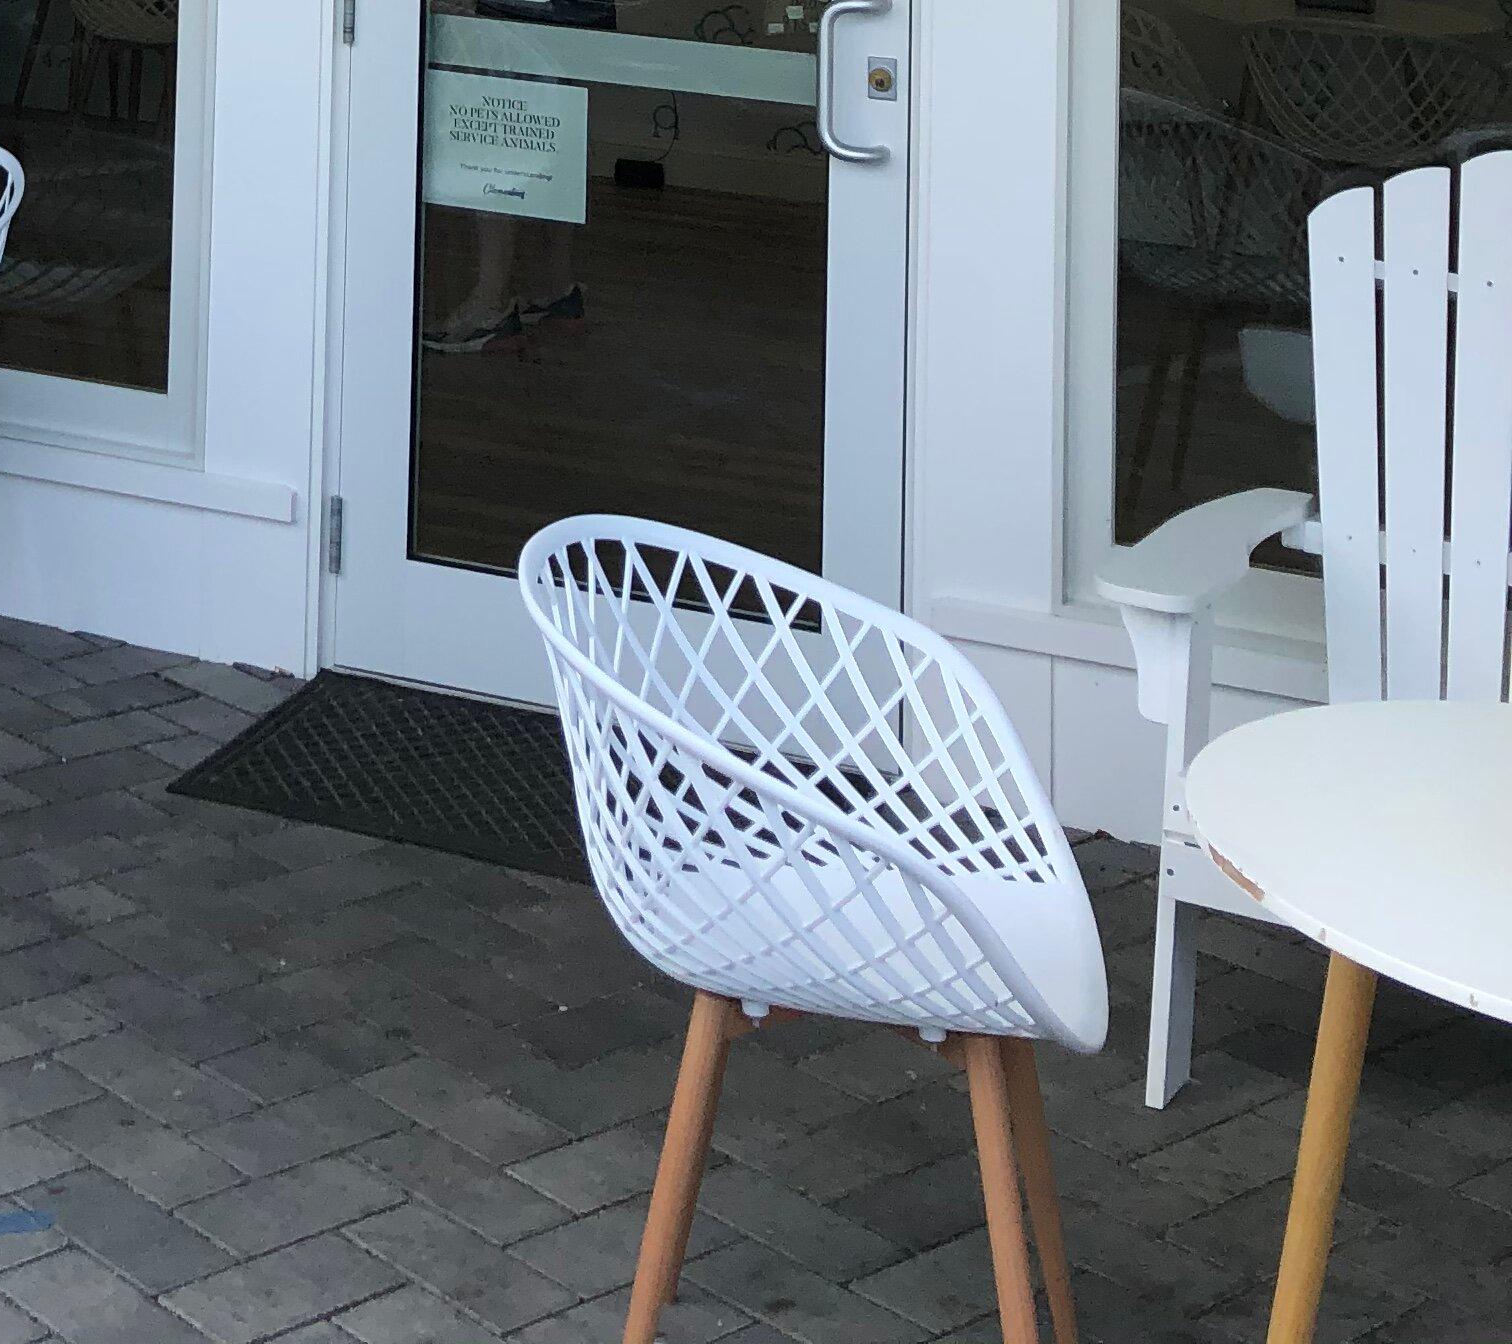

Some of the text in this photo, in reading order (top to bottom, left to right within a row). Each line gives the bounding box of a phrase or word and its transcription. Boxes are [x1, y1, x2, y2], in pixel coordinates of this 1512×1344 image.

[482, 95, 527, 111] NOTICE
[449, 104, 468, 116] NO
[502, 111, 561, 128] ALLOWED
[502, 123, 555, 140] TRAINED
[449, 131, 556, 153] SERVICE ANIMALS
